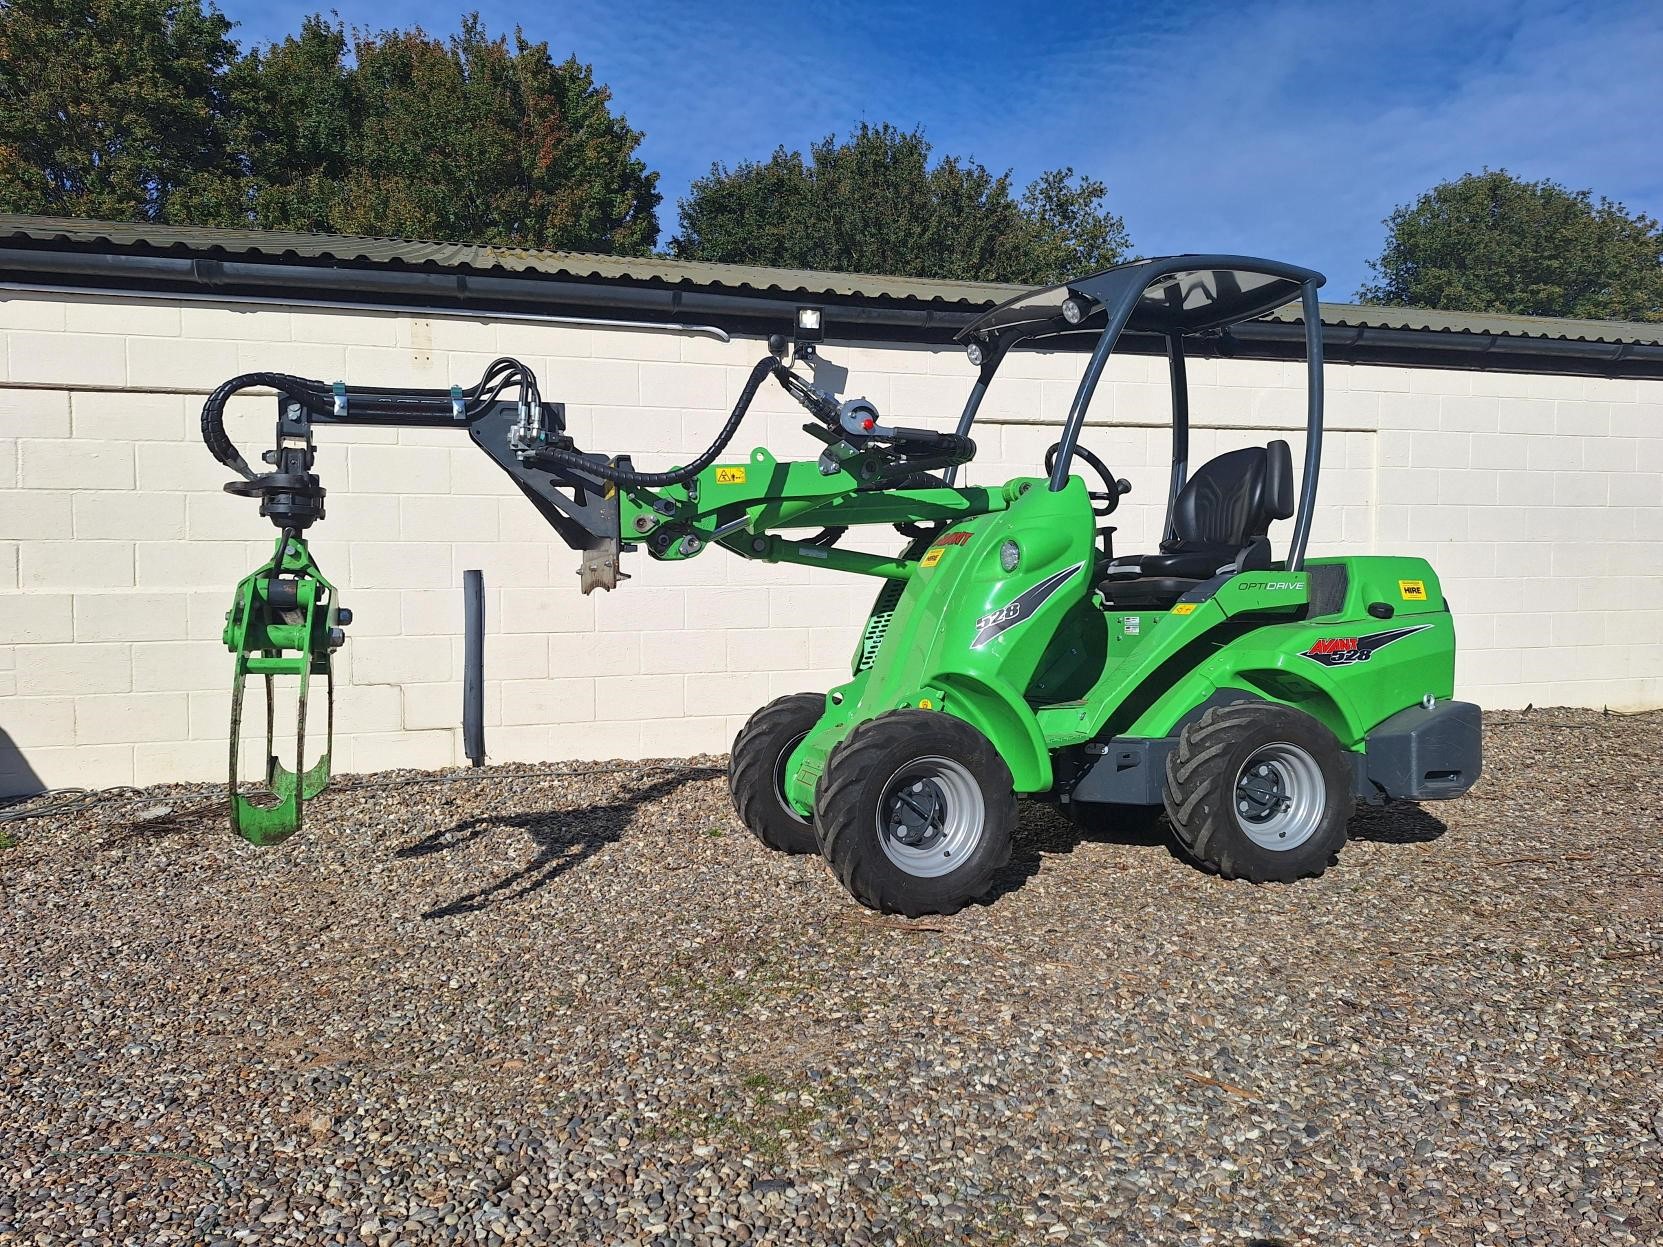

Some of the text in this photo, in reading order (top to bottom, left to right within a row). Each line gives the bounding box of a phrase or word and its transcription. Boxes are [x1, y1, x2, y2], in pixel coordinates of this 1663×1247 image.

[1238, 582, 1305, 591] OPTIDRIVE
[1403, 586, 1422, 594] HIRE
[976, 603, 1020, 630] 528
[1307, 637, 1358, 655] AVANT
[1330, 649, 1373, 662] 528
